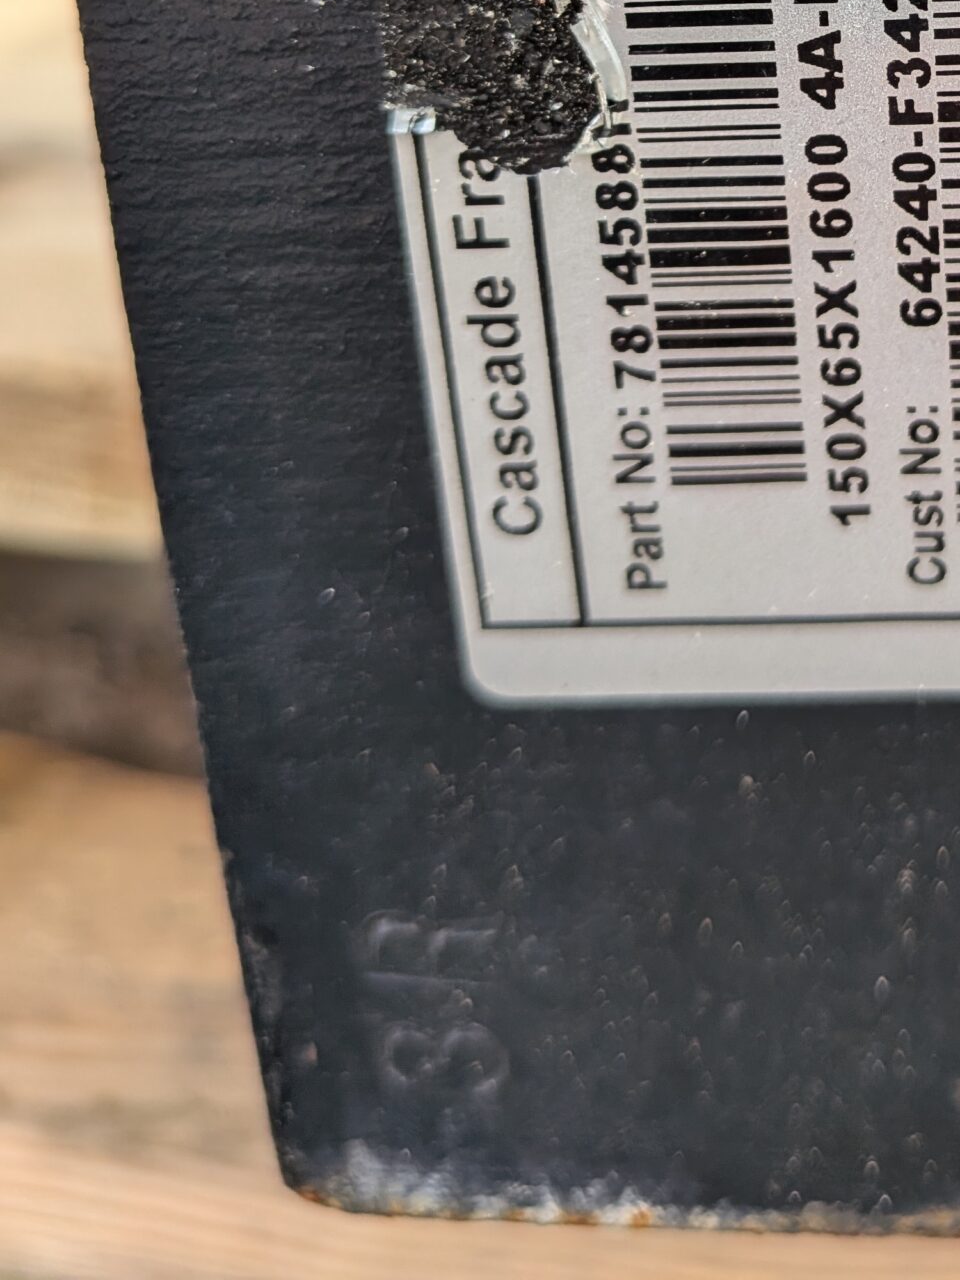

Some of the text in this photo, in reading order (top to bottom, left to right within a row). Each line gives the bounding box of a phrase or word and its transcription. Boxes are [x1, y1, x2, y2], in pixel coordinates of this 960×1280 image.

[804, 133, 871, 527] 150X65X1600
[466, 276, 543, 535] Cascade
[612, 406, 657, 484] No:
[899, 405, 942, 477] No:
[619, 500, 668, 590] Part
[905, 489, 947, 586] Cust
